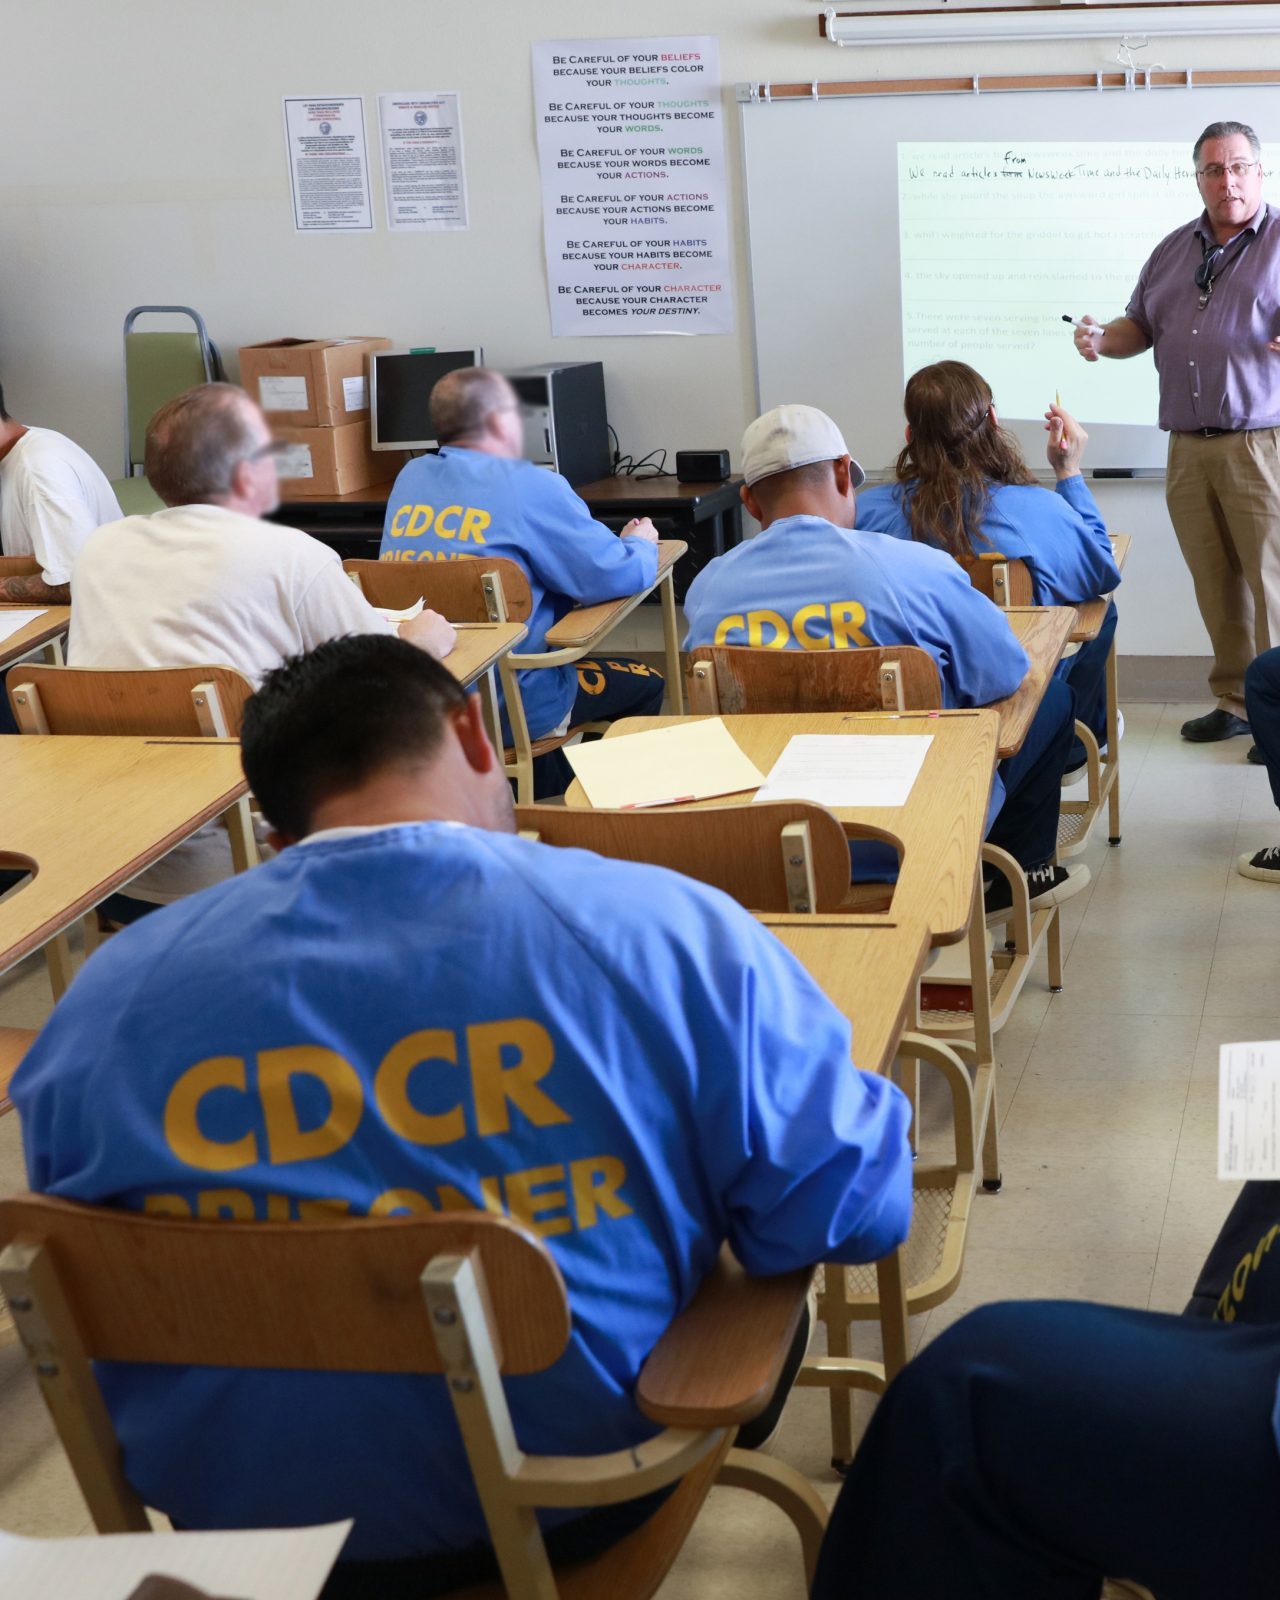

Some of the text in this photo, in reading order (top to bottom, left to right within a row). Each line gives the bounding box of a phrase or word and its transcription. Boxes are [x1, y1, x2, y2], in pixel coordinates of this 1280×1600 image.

[553, 56, 566, 64] BE
[569, 55, 615, 63] CAREFUL
[617, 55, 630, 63] OF
[661, 53, 700, 61] BELIEFS
[565, 102, 611, 110] CAREFUL
[658, 100, 709, 108] THOUGHTS
[933, 164, 955, 178] read
[961, 166, 998, 180] articles
[1104, 164, 1121, 177] and
[1124, 167, 1140, 177] the
[1144, 166, 1170, 185] Daily
[561, 195, 574, 203] BE
[583, 240, 628, 248] CAREFUL
[574, 285, 619, 293] CAREFUL
[390, 504, 492, 544] CDCR
[714, 600, 876, 649] CDCR
[163, 1017, 573, 1171] CDCR
